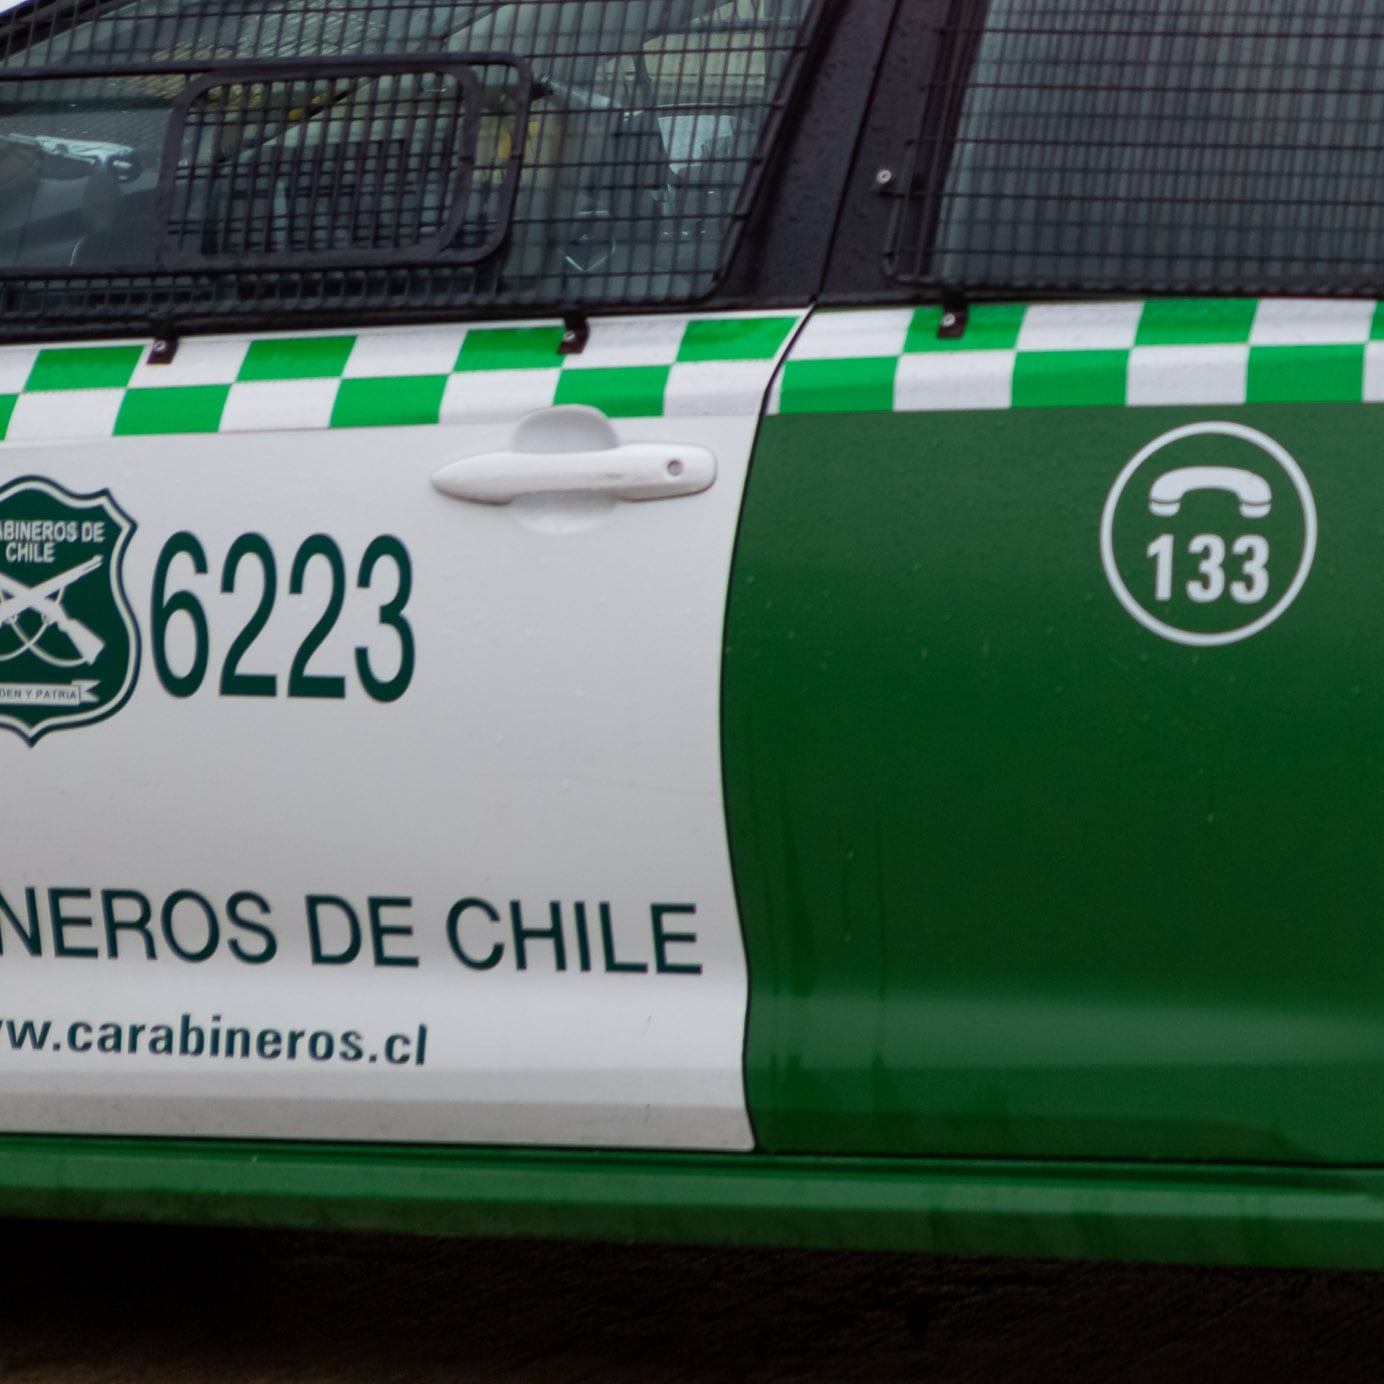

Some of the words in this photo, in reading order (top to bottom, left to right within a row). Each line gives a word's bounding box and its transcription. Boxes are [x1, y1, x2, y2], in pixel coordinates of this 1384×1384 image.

[5, 542, 56, 563] CHILE
[81, 521, 106, 543] DE
[1146, 533, 1270, 604] 133
[151, 531, 416, 702] 6223
[36, 688, 77, 700] PATRIA
[304, 893, 420, 967] DE
[445, 897, 704, 975] CHILE
[0, 1014, 428, 1066] w.carabineros.cl
